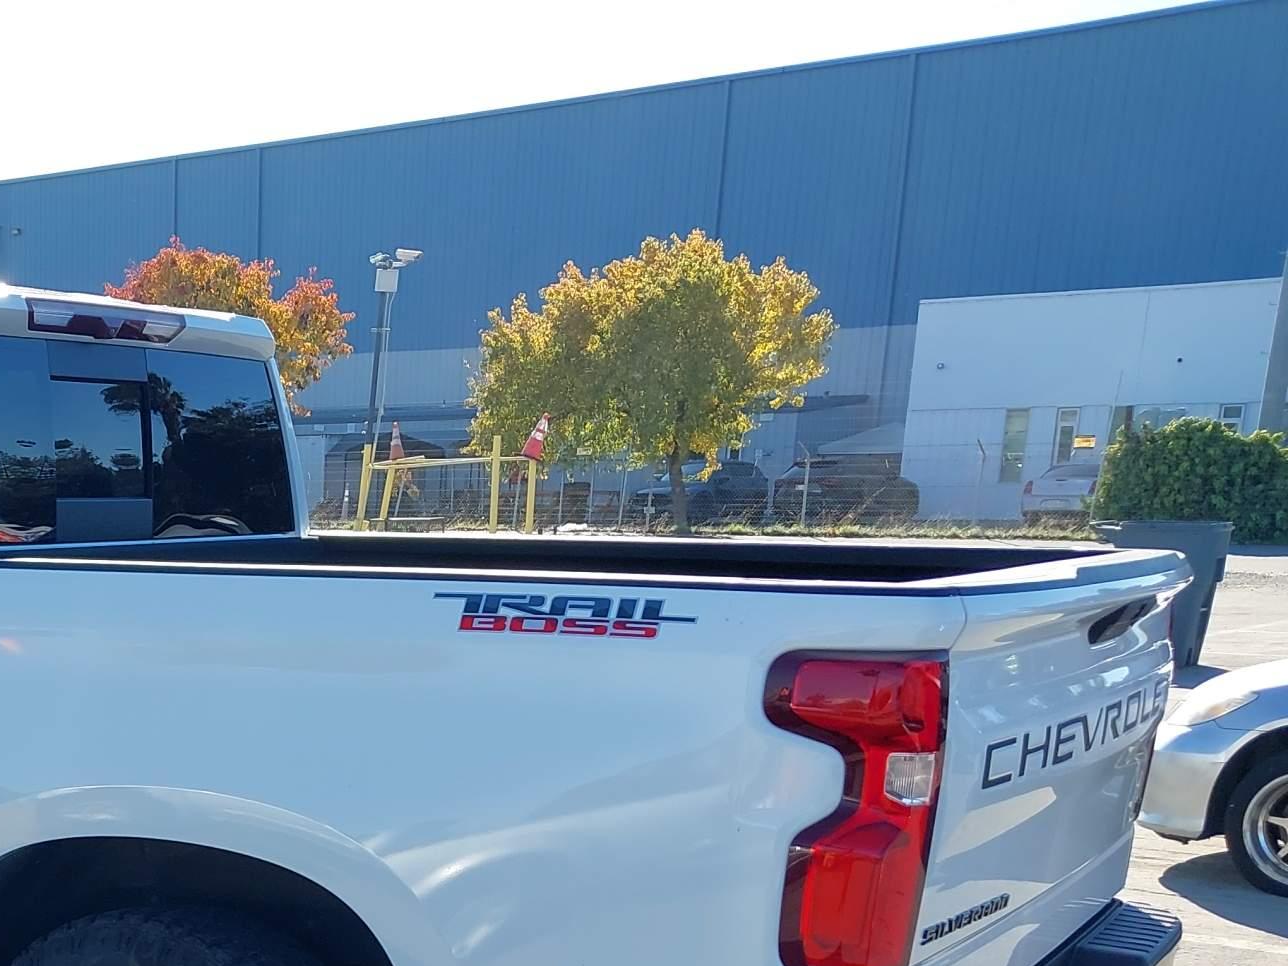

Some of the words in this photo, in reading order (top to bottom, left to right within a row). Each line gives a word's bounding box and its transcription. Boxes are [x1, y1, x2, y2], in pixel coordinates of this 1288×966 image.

[433, 593, 698, 624] TRAIL
[458, 614, 661, 639] BOSS
[981, 676, 1170, 790] CHEVROLE
